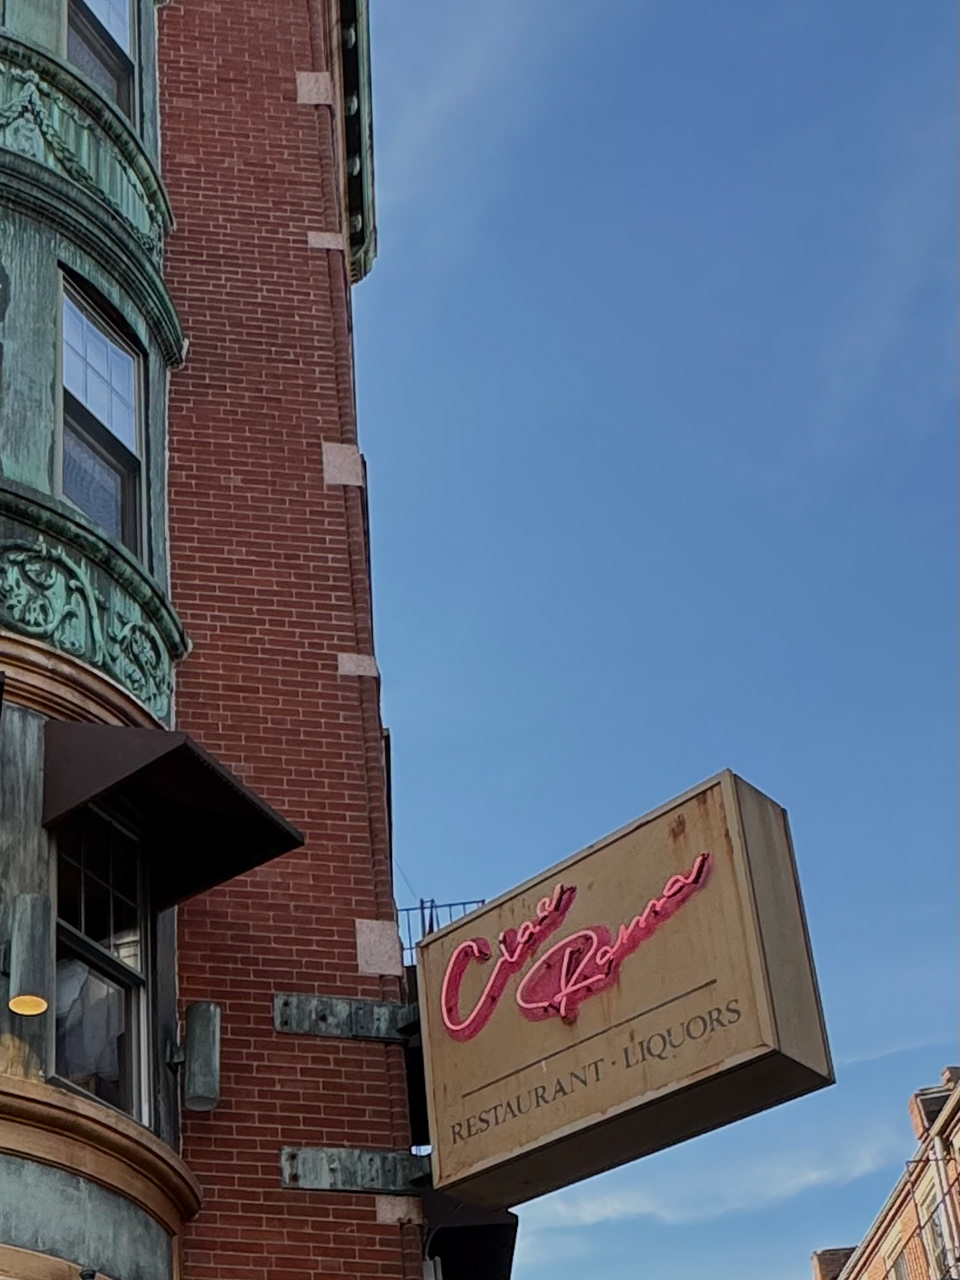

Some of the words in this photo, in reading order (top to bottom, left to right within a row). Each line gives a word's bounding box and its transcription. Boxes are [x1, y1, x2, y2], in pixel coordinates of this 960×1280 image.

[442, 883, 576, 1040] Ciao
[516, 852, 712, 1023] Roma
[450, 1058, 604, 1145] RESTAURANT
[623, 998, 741, 1070] LIQUORS
